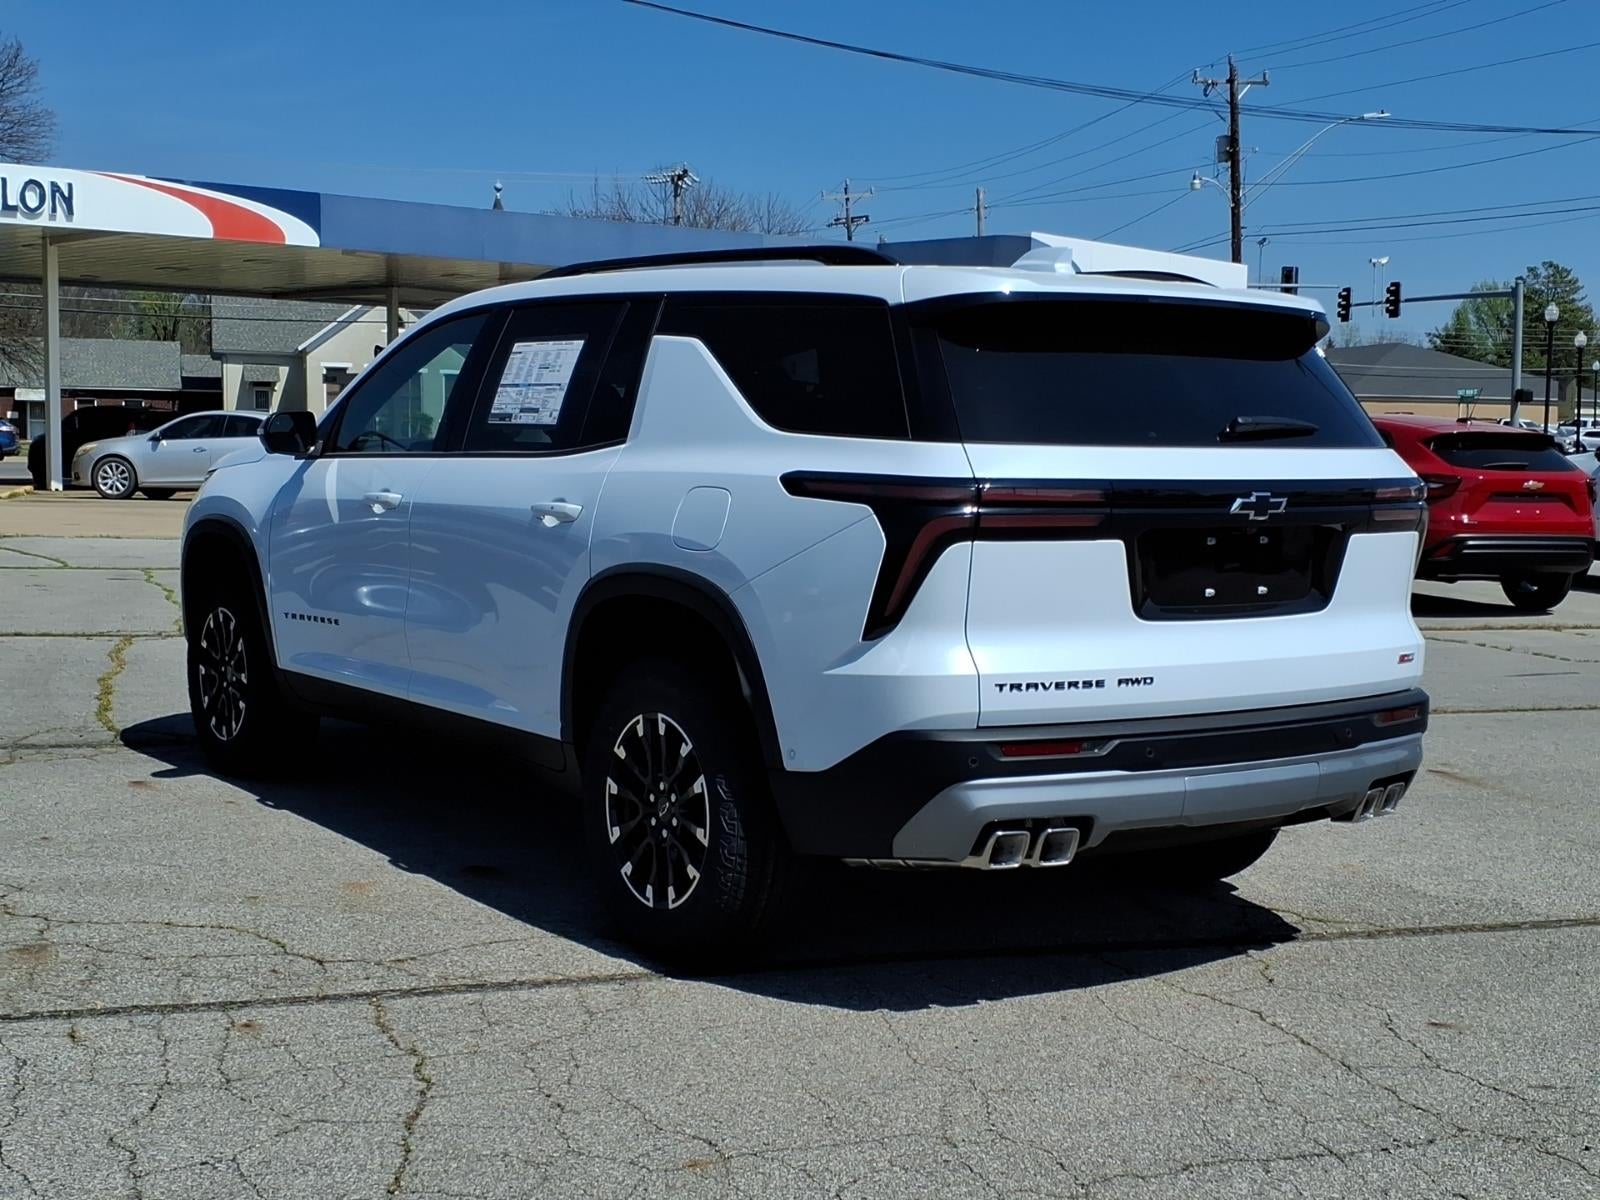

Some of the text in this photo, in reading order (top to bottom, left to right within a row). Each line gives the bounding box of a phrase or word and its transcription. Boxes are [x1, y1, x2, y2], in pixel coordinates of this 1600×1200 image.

[0, 177, 74, 217] LON
[283, 612, 340, 626] TRAVERSE
[994, 676, 1154, 693] TRAVERSE AWD
